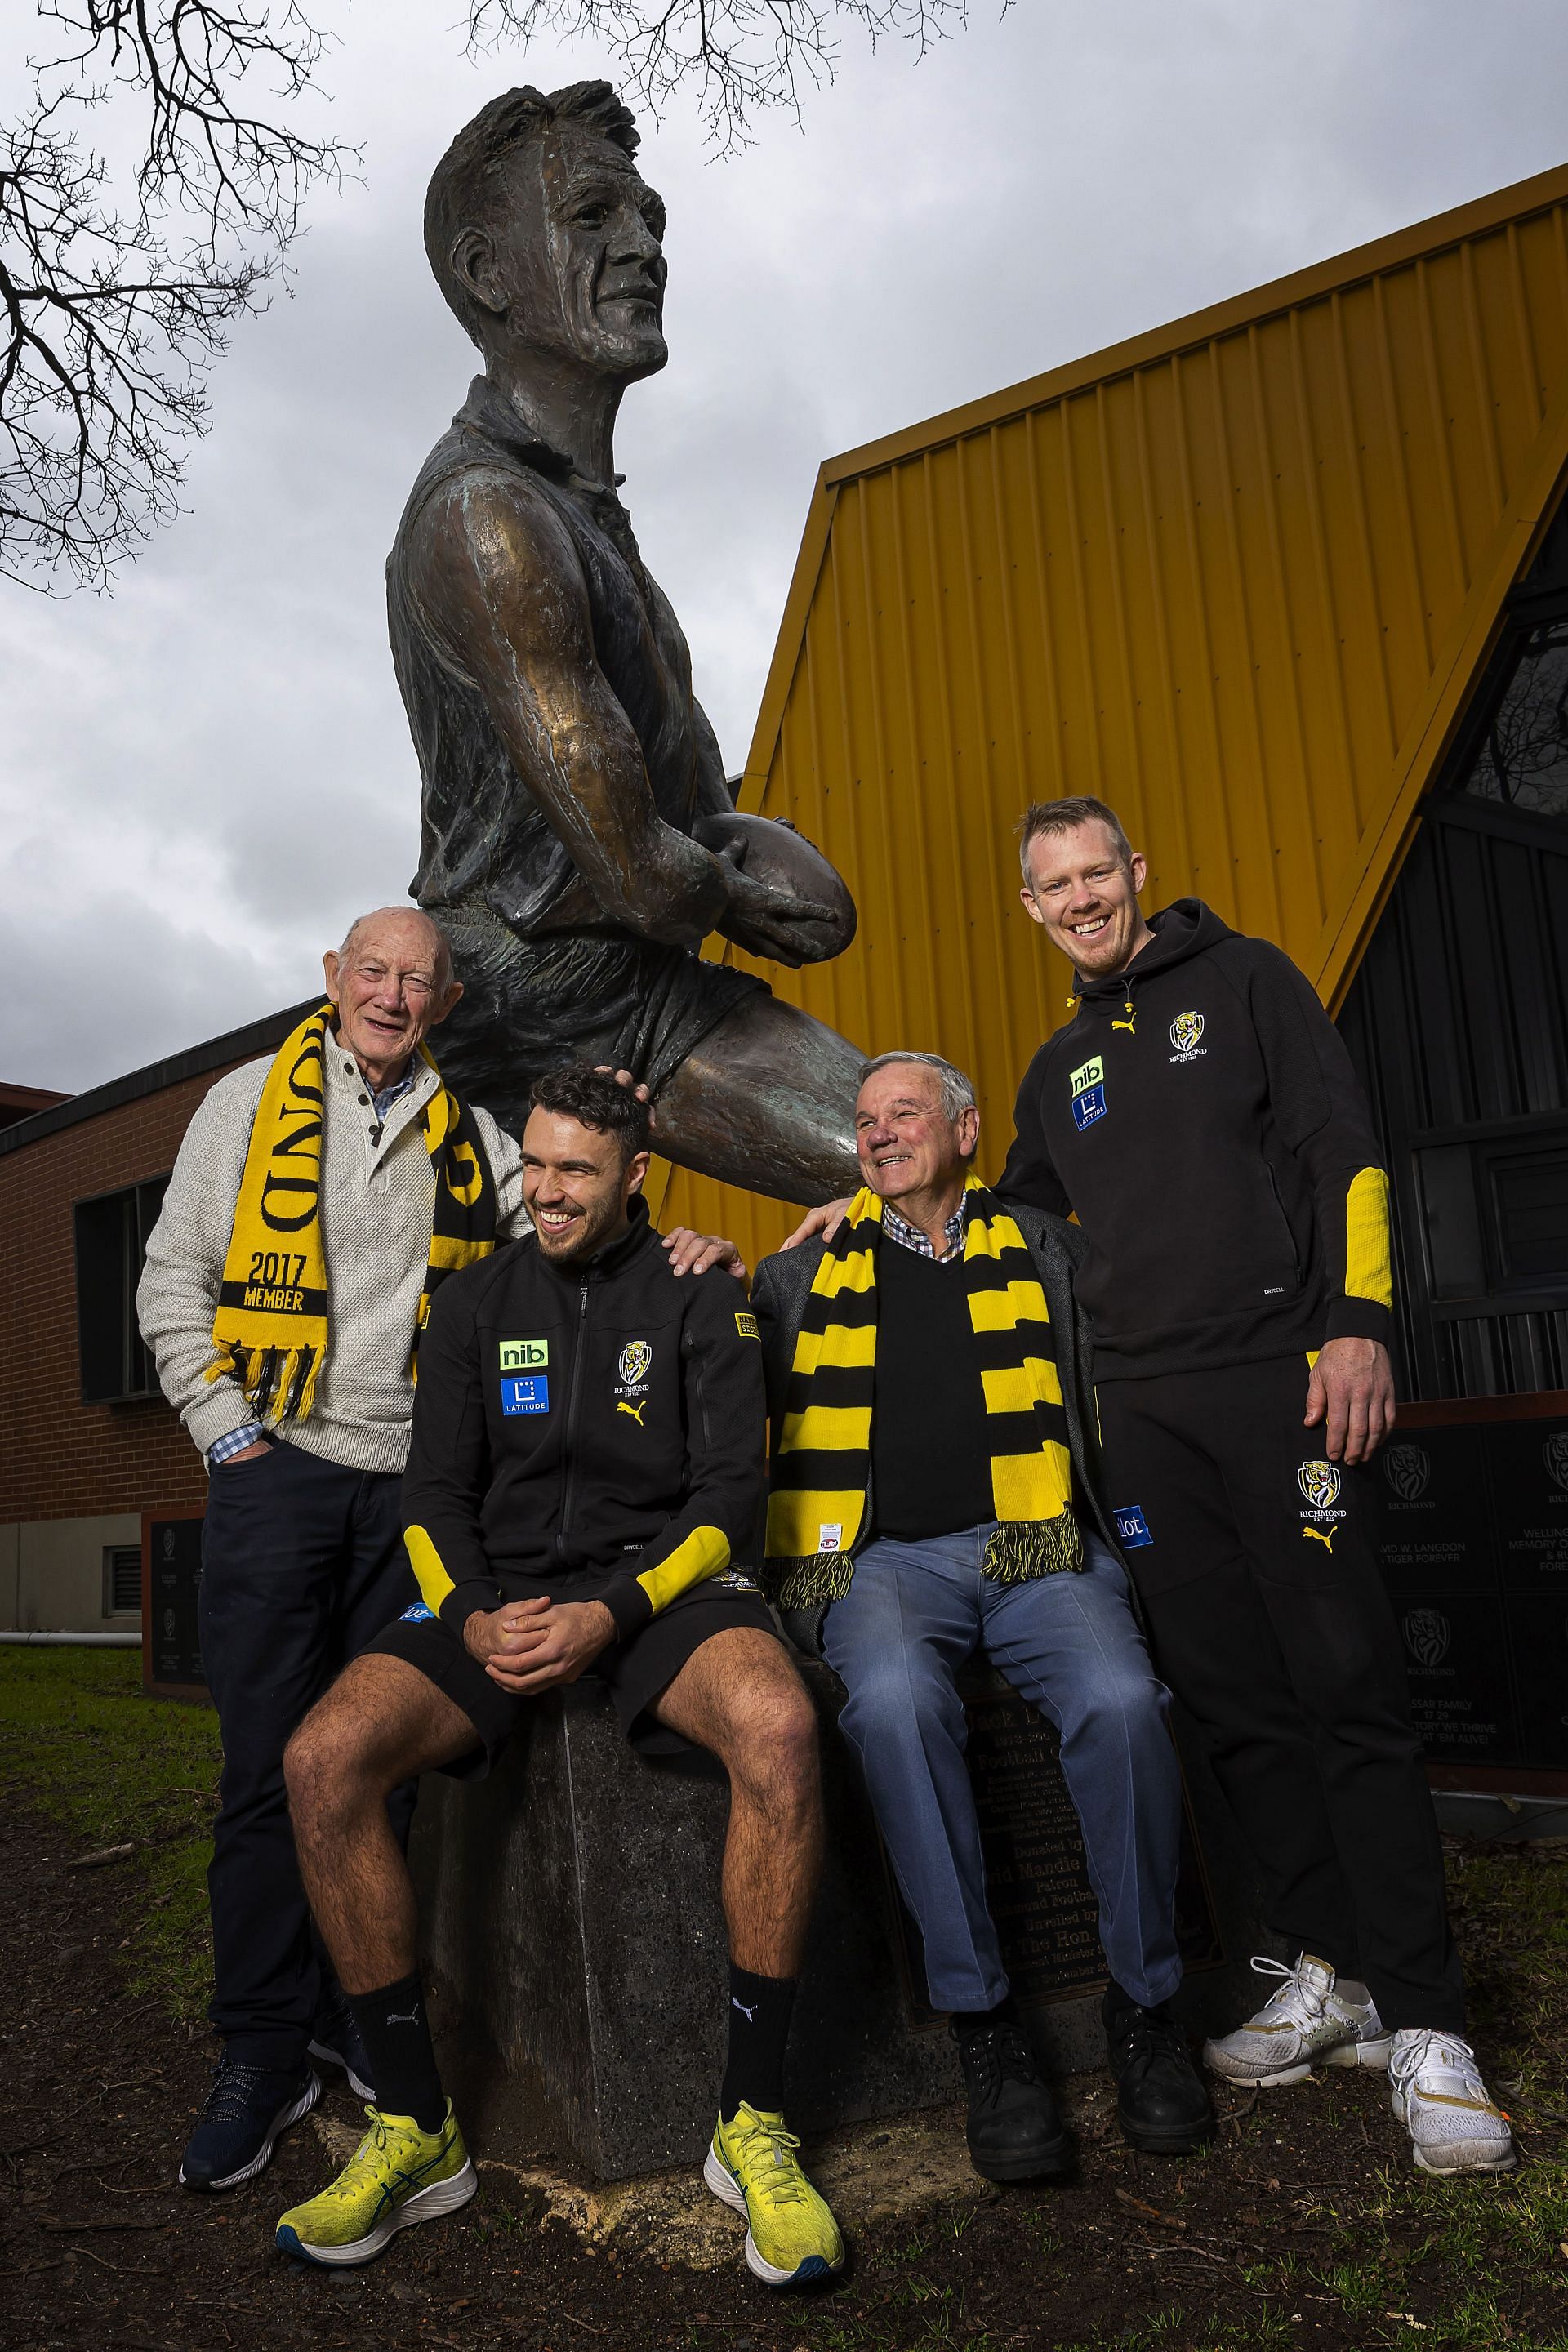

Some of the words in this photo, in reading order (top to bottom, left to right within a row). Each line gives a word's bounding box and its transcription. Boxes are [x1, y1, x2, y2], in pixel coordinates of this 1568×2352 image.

[1169, 1048, 1207, 1063] RICHMOND
[1074, 1065, 1100, 1092] nib
[1079, 1106, 1104, 1126] LATITUDE
[248, 1252, 307, 1287] 2017
[244, 1286, 303, 1312] MEMBER
[503, 1345, 545, 1365] nib
[614, 1384, 649, 1394] RICHMOND
[506, 1402, 546, 1412] LATITUDE
[1299, 1509, 1347, 1517] RICHMOND
[1388, 1502, 1436, 1510] RICHMOND
[1380, 1544, 1398, 1554] VID
[1414, 1541, 1466, 1552] LANGDON
[1509, 1539, 1555, 1550] MEMORY
[1386, 1554, 1414, 1564] TIGER
[1416, 1552, 1460, 1564] FOREVER
[1546, 1551, 1555, 1561] &
[1407, 1667, 1455, 1677] RICHMOND
[1410, 1699, 1435, 1709] SSAR
[1437, 1699, 1472, 1712] FAMILY
[1411, 1722, 1439, 1731] TORY
[1441, 1722, 1459, 1732] WE
[1461, 1724, 1497, 1734] THRIVE
[1013, 1841, 1066, 1860] Donated
[1067, 1838, 1084, 1852] by
[1018, 1855, 1081, 1879] Mandie
[1036, 1878, 1079, 1894] Patron
[991, 1896, 1049, 1918] ichmond
[1024, 1910, 1080, 1931] Unveiled
[1081, 1909, 1099, 1922] by
[1018, 1936, 1050, 1956] The
[1054, 1930, 1096, 1948] Hon.
